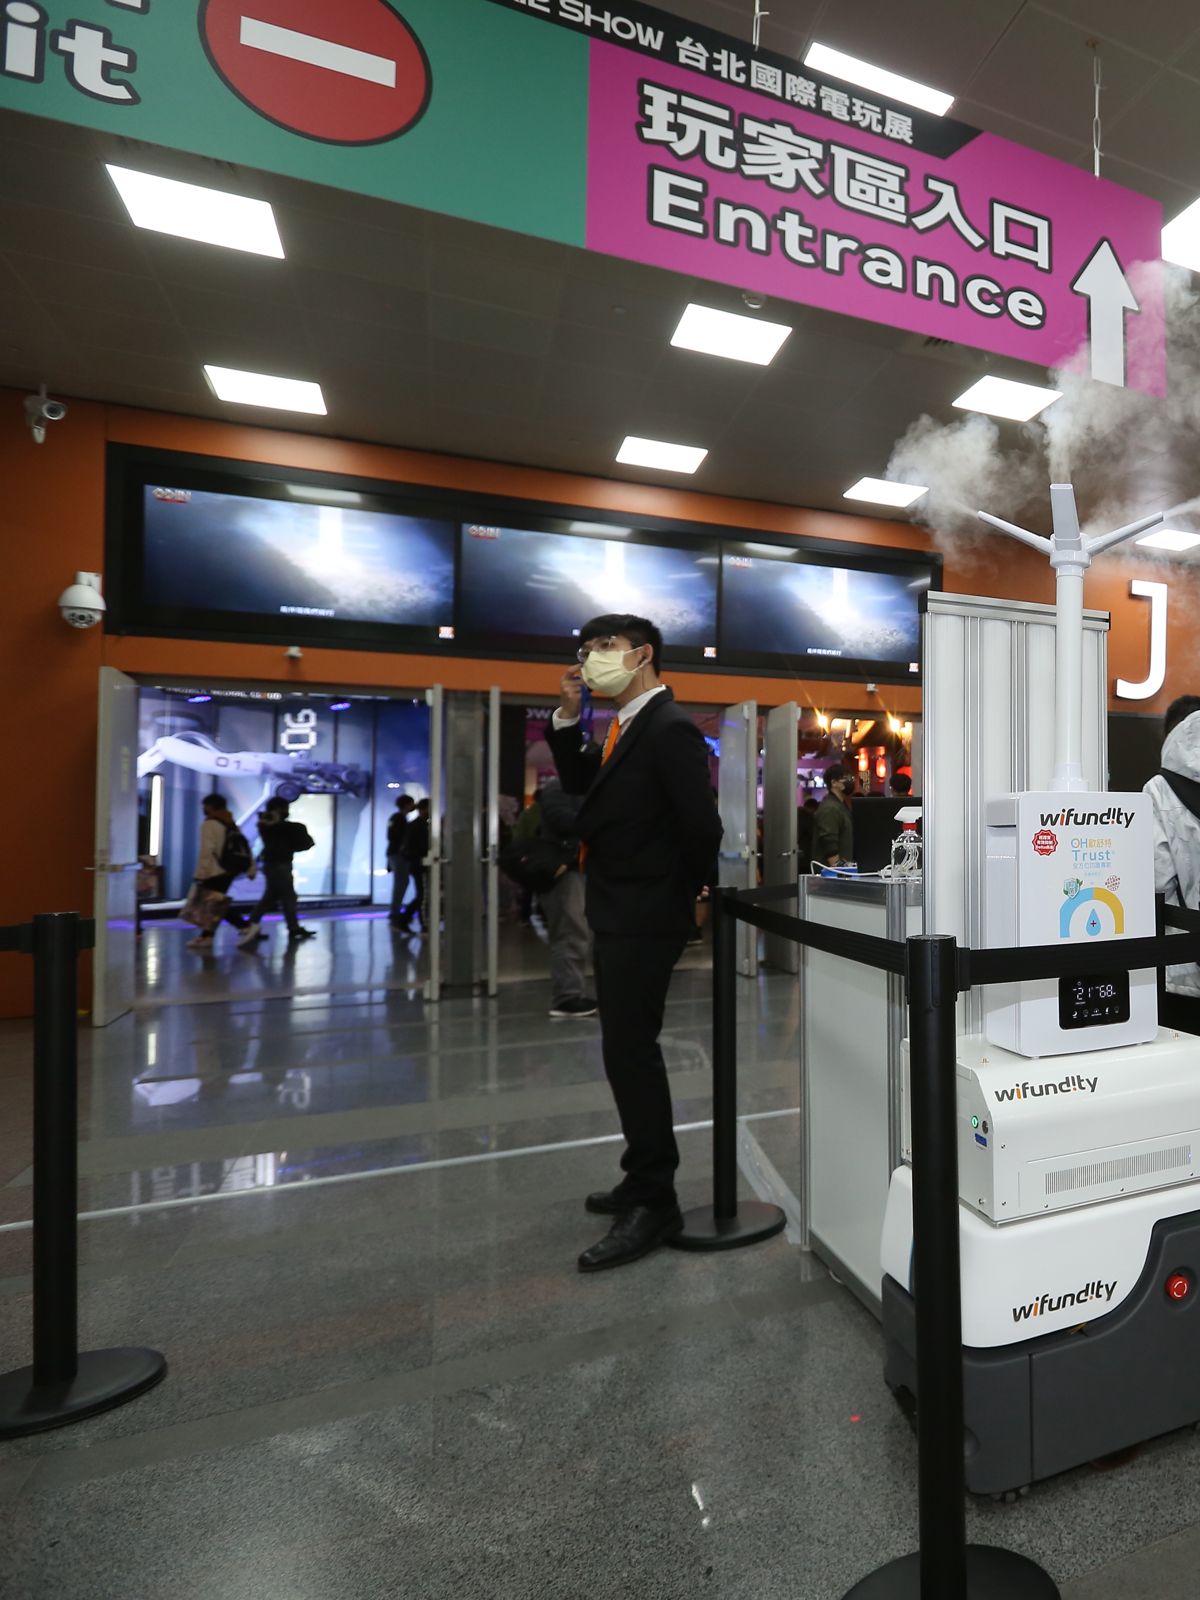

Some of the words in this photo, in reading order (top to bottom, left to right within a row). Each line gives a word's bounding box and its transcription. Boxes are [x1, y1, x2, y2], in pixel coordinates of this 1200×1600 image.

[559, 0, 664, 51] SHOW
[676, 36, 914, 145] 台北國際電玩展
[641, 84, 1051, 271] 玩家區入口
[651, 168, 1046, 328] Entrance
[1115, 579, 1169, 700] J
[1072, 850, 1111, 862] Trust
